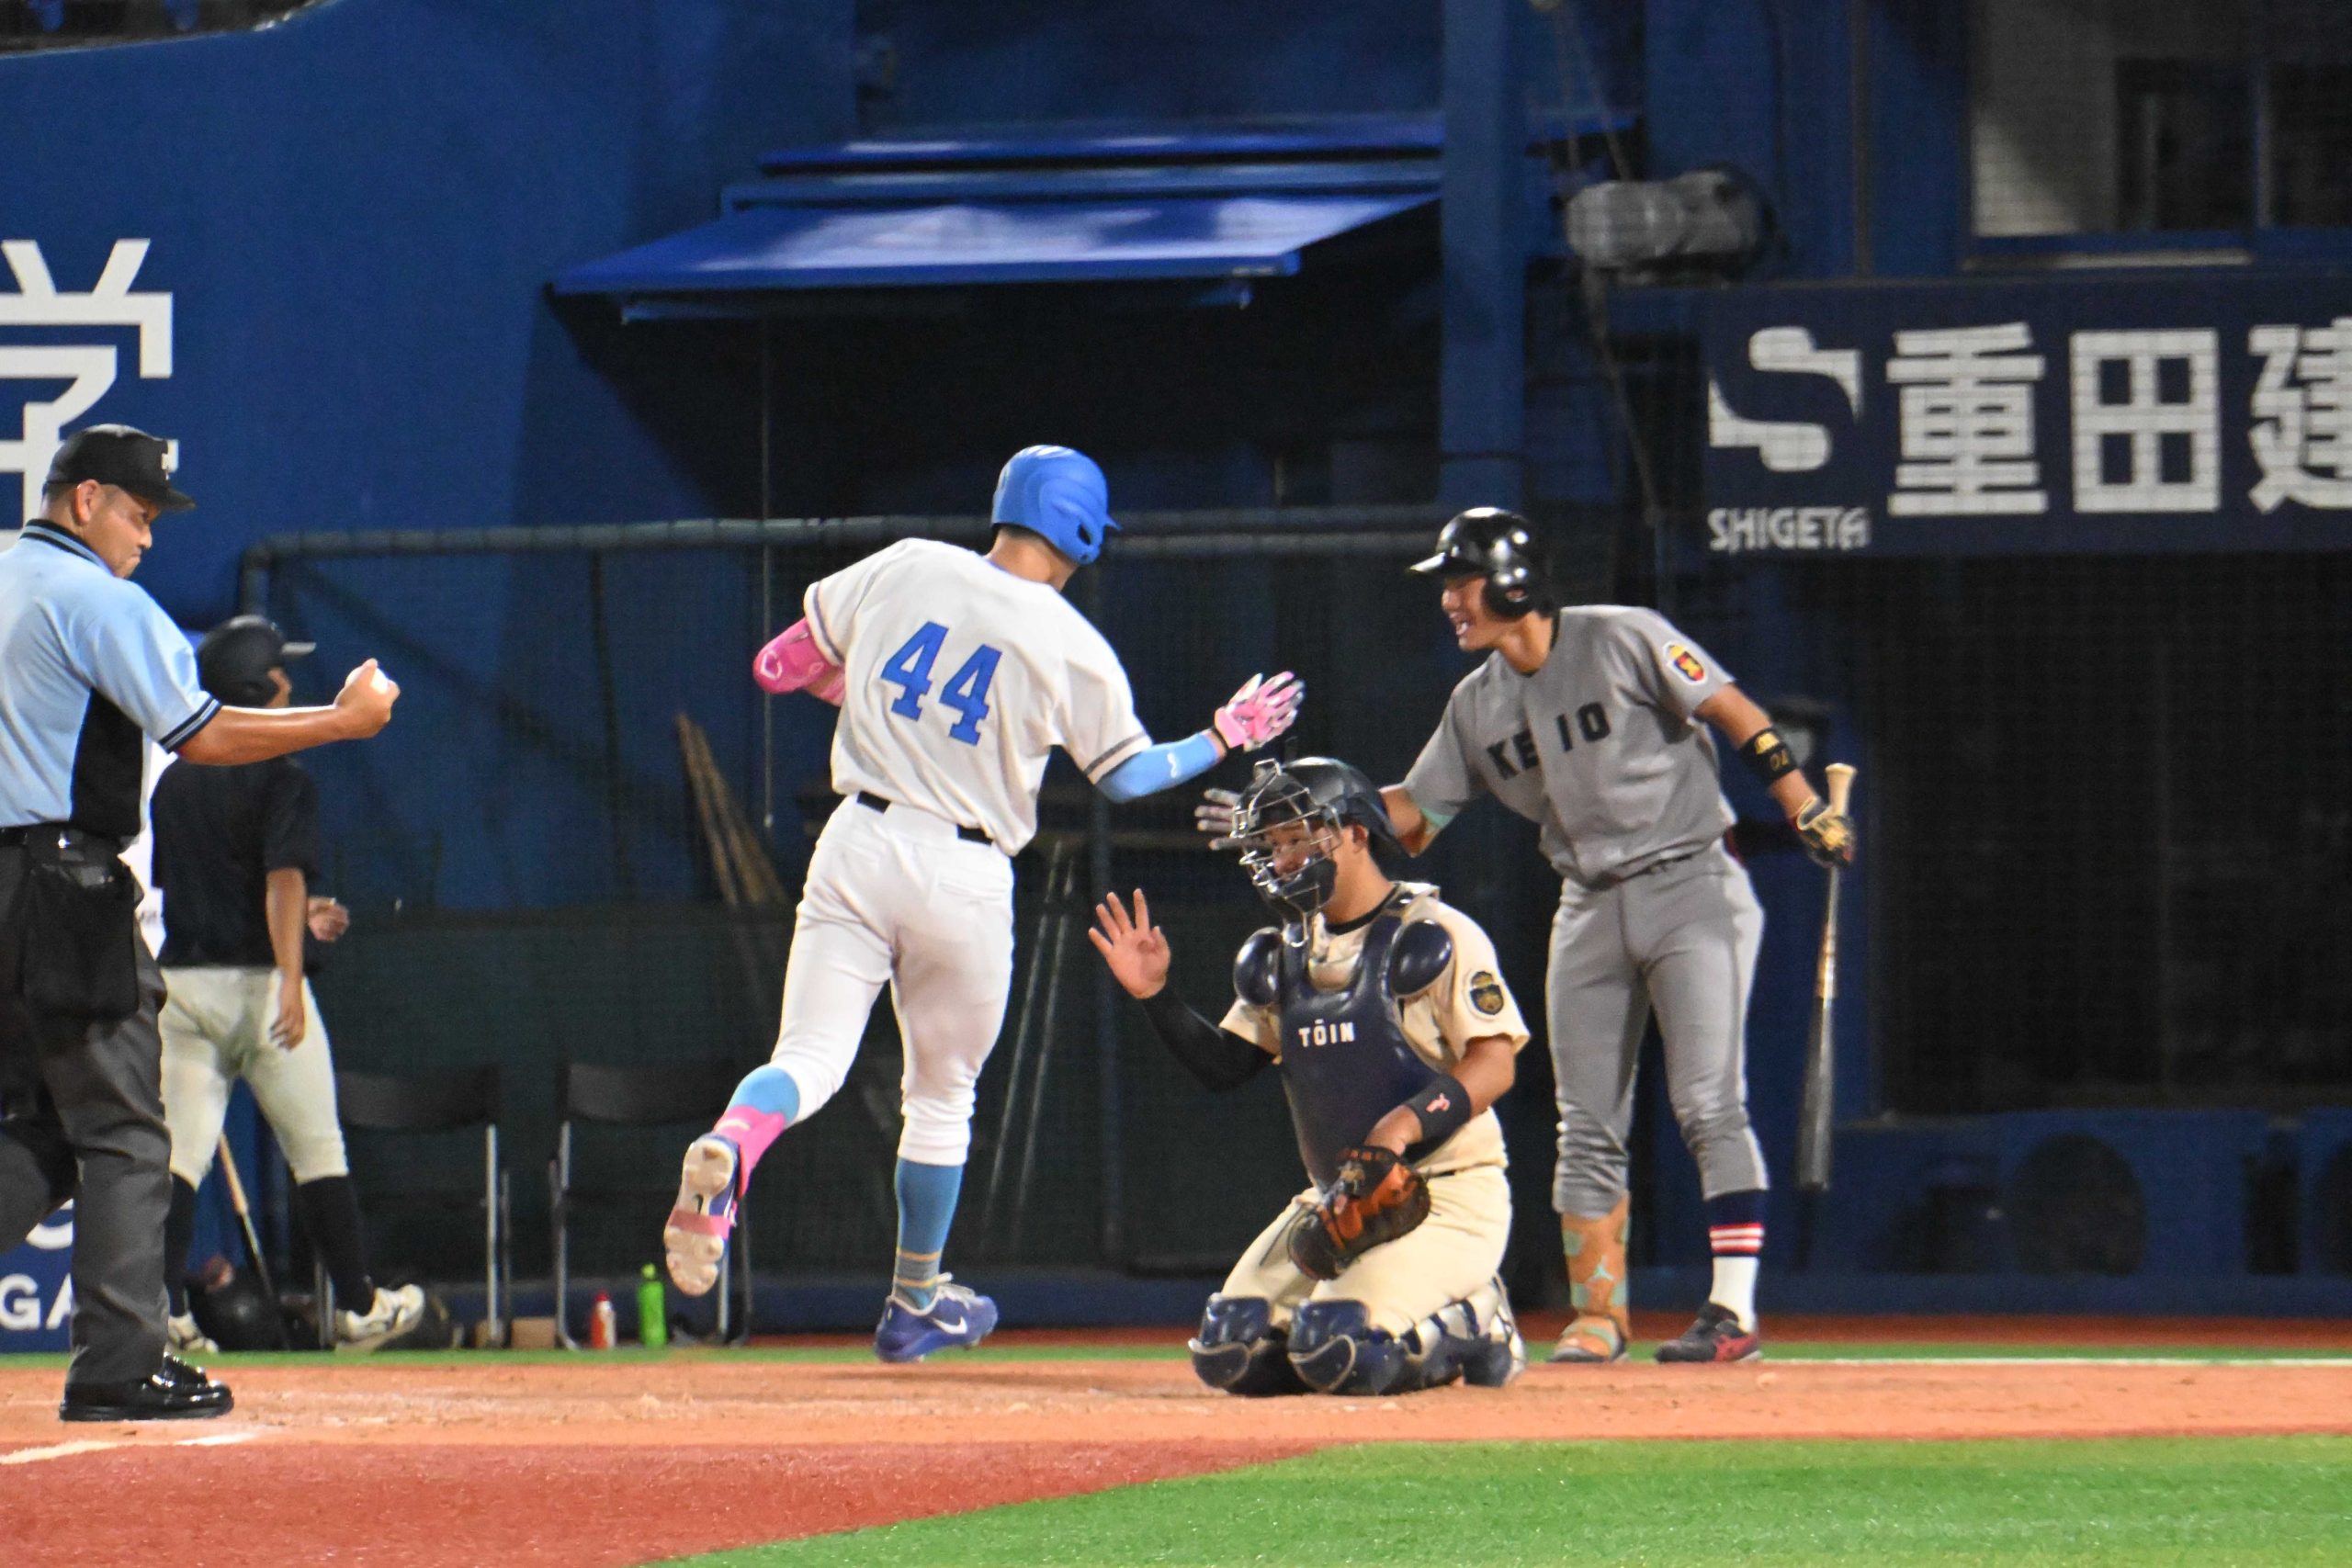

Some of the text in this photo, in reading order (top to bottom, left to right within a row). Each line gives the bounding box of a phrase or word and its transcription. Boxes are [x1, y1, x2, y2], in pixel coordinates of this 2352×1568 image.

[1886, 318, 2352, 516] 重田建
[1707, 506, 1869, 554] SHIGETA
[880, 621, 1002, 747] 44
[1487, 702, 1611, 780] KEIO
